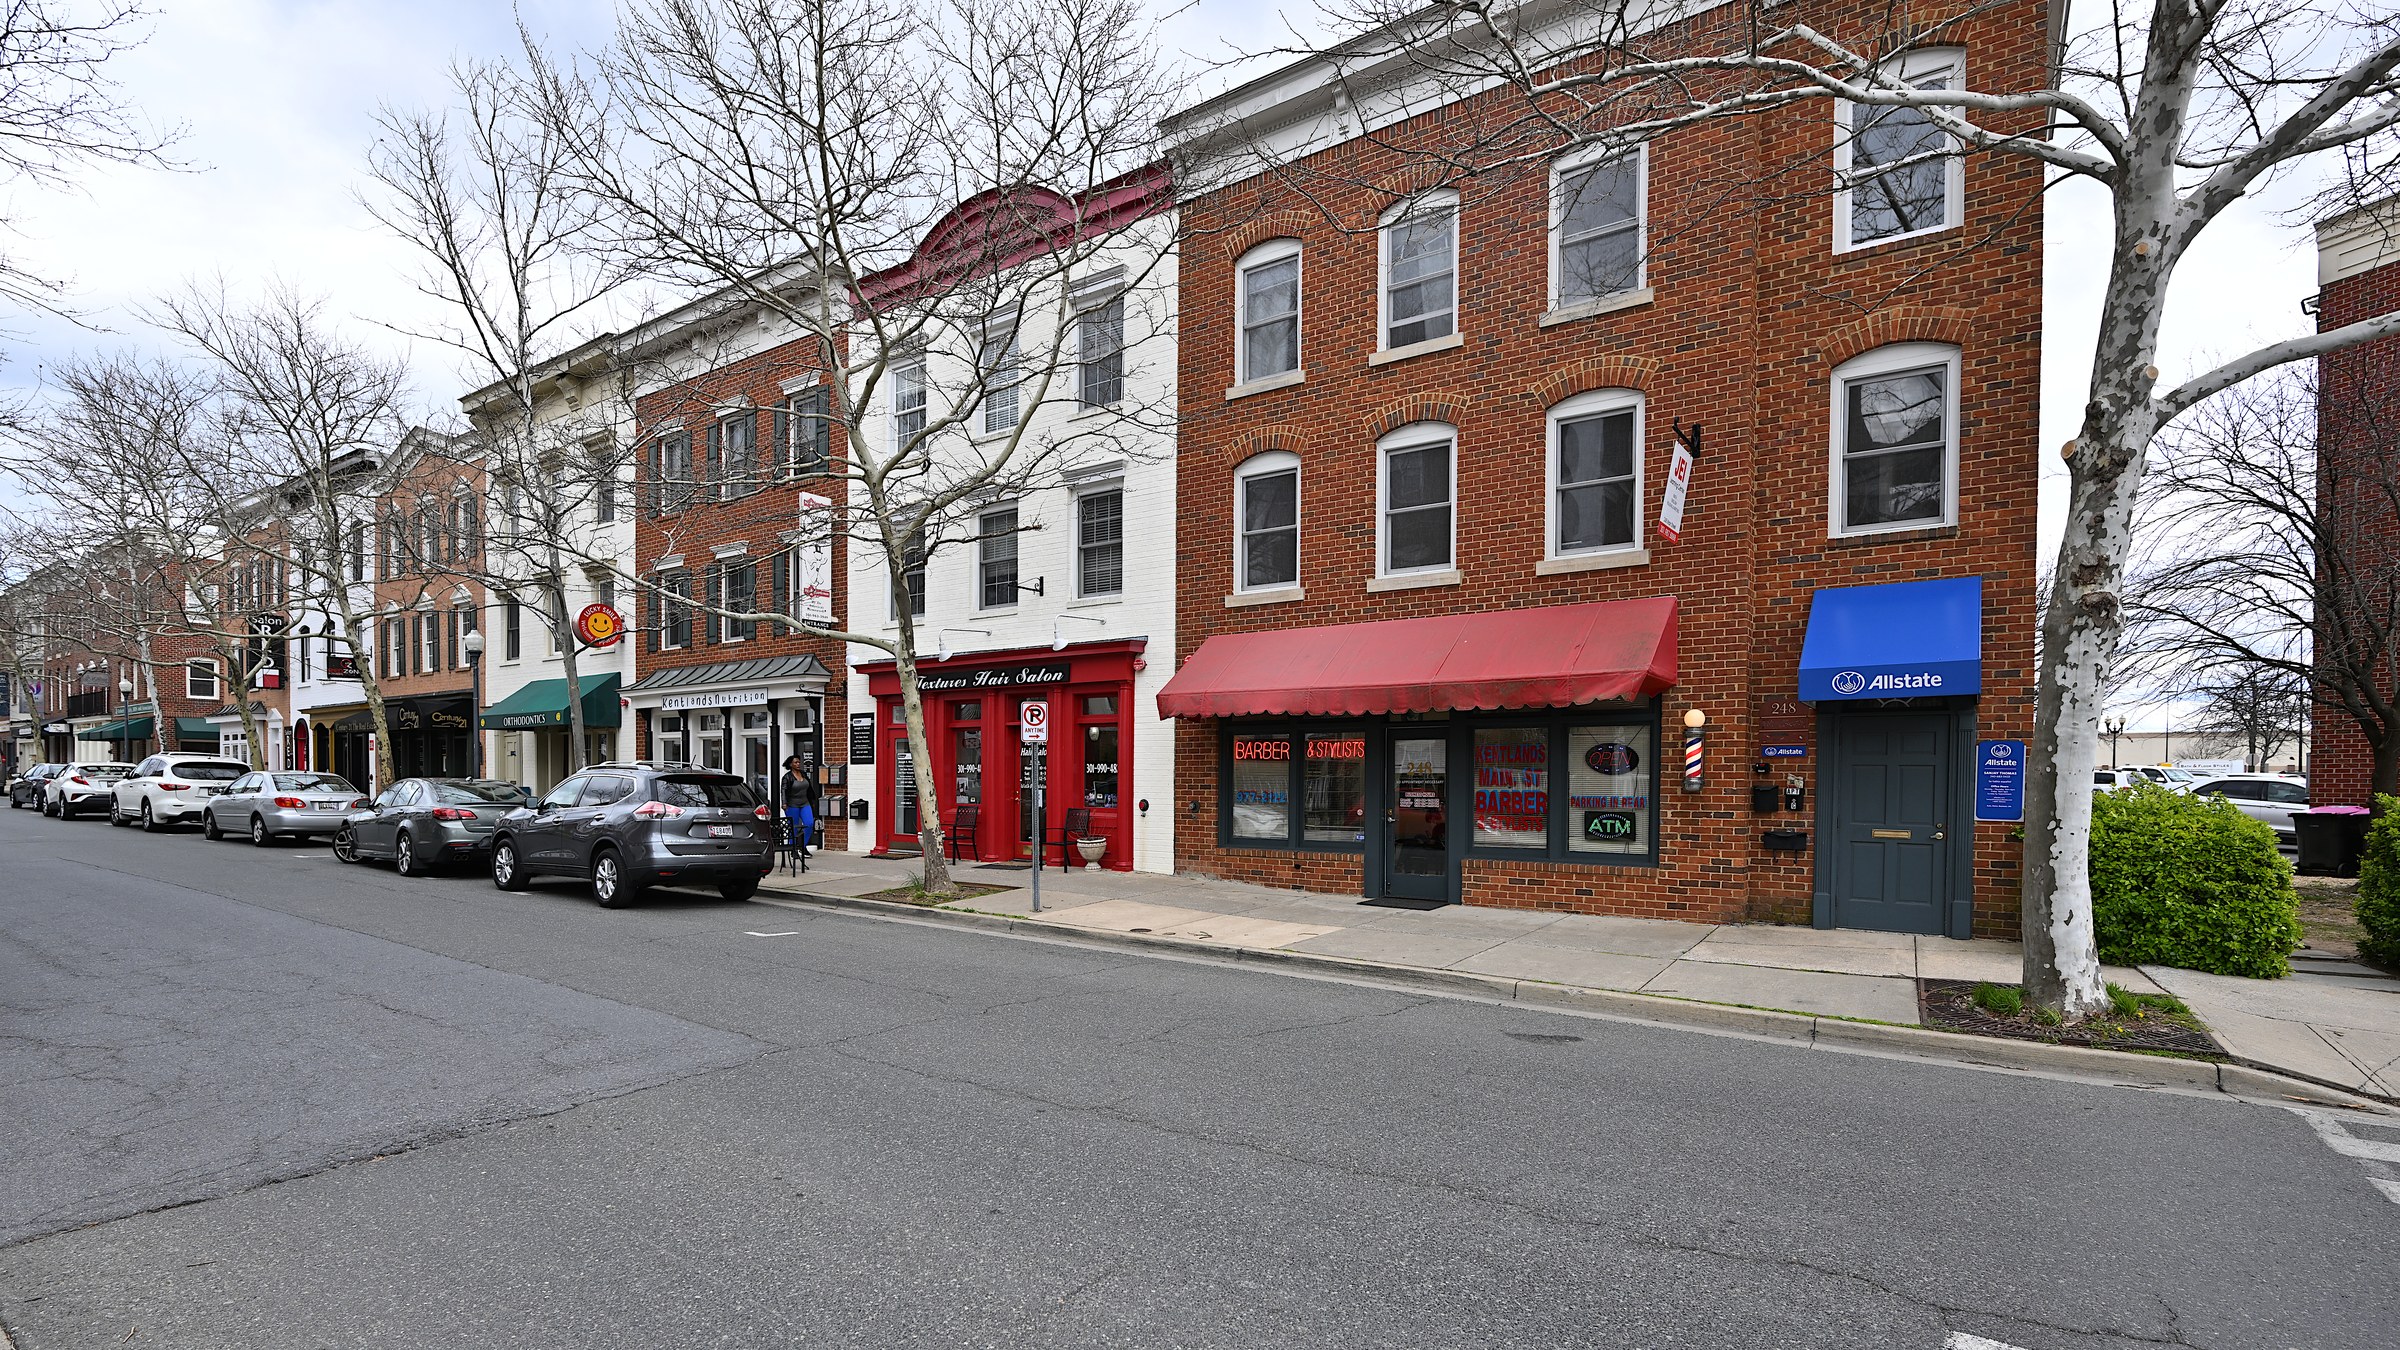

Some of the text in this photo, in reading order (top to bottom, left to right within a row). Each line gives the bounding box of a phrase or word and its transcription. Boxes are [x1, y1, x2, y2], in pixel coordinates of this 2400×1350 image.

[1674, 456, 1688, 482] JEI
[583, 606, 617, 620] LUCKY SMILE
[916, 667, 1064, 691] Textures Hair Salon
[1868, 673, 1942, 690] Allstate
[1772, 702, 1797, 714] 248
[432, 712, 467, 728] Century 21
[503, 713, 546, 727] ORTHODONTICS
[1235, 741, 1365, 760] BARBER & STYLISTS
[1475, 744, 1546, 763] KENTLANDS
[1590, 752, 1633, 767] OPEN
[1985, 759, 2018, 767] Allstate
[1407, 761, 1432, 777] 248
[1522, 768, 1543, 788] ST
[1475, 790, 1547, 815] BARBER
[1570, 796, 1647, 809] PARKING IN REAR
[1490, 816, 1544, 832] STYLISTS
[1588, 818, 1631, 833] ATM
